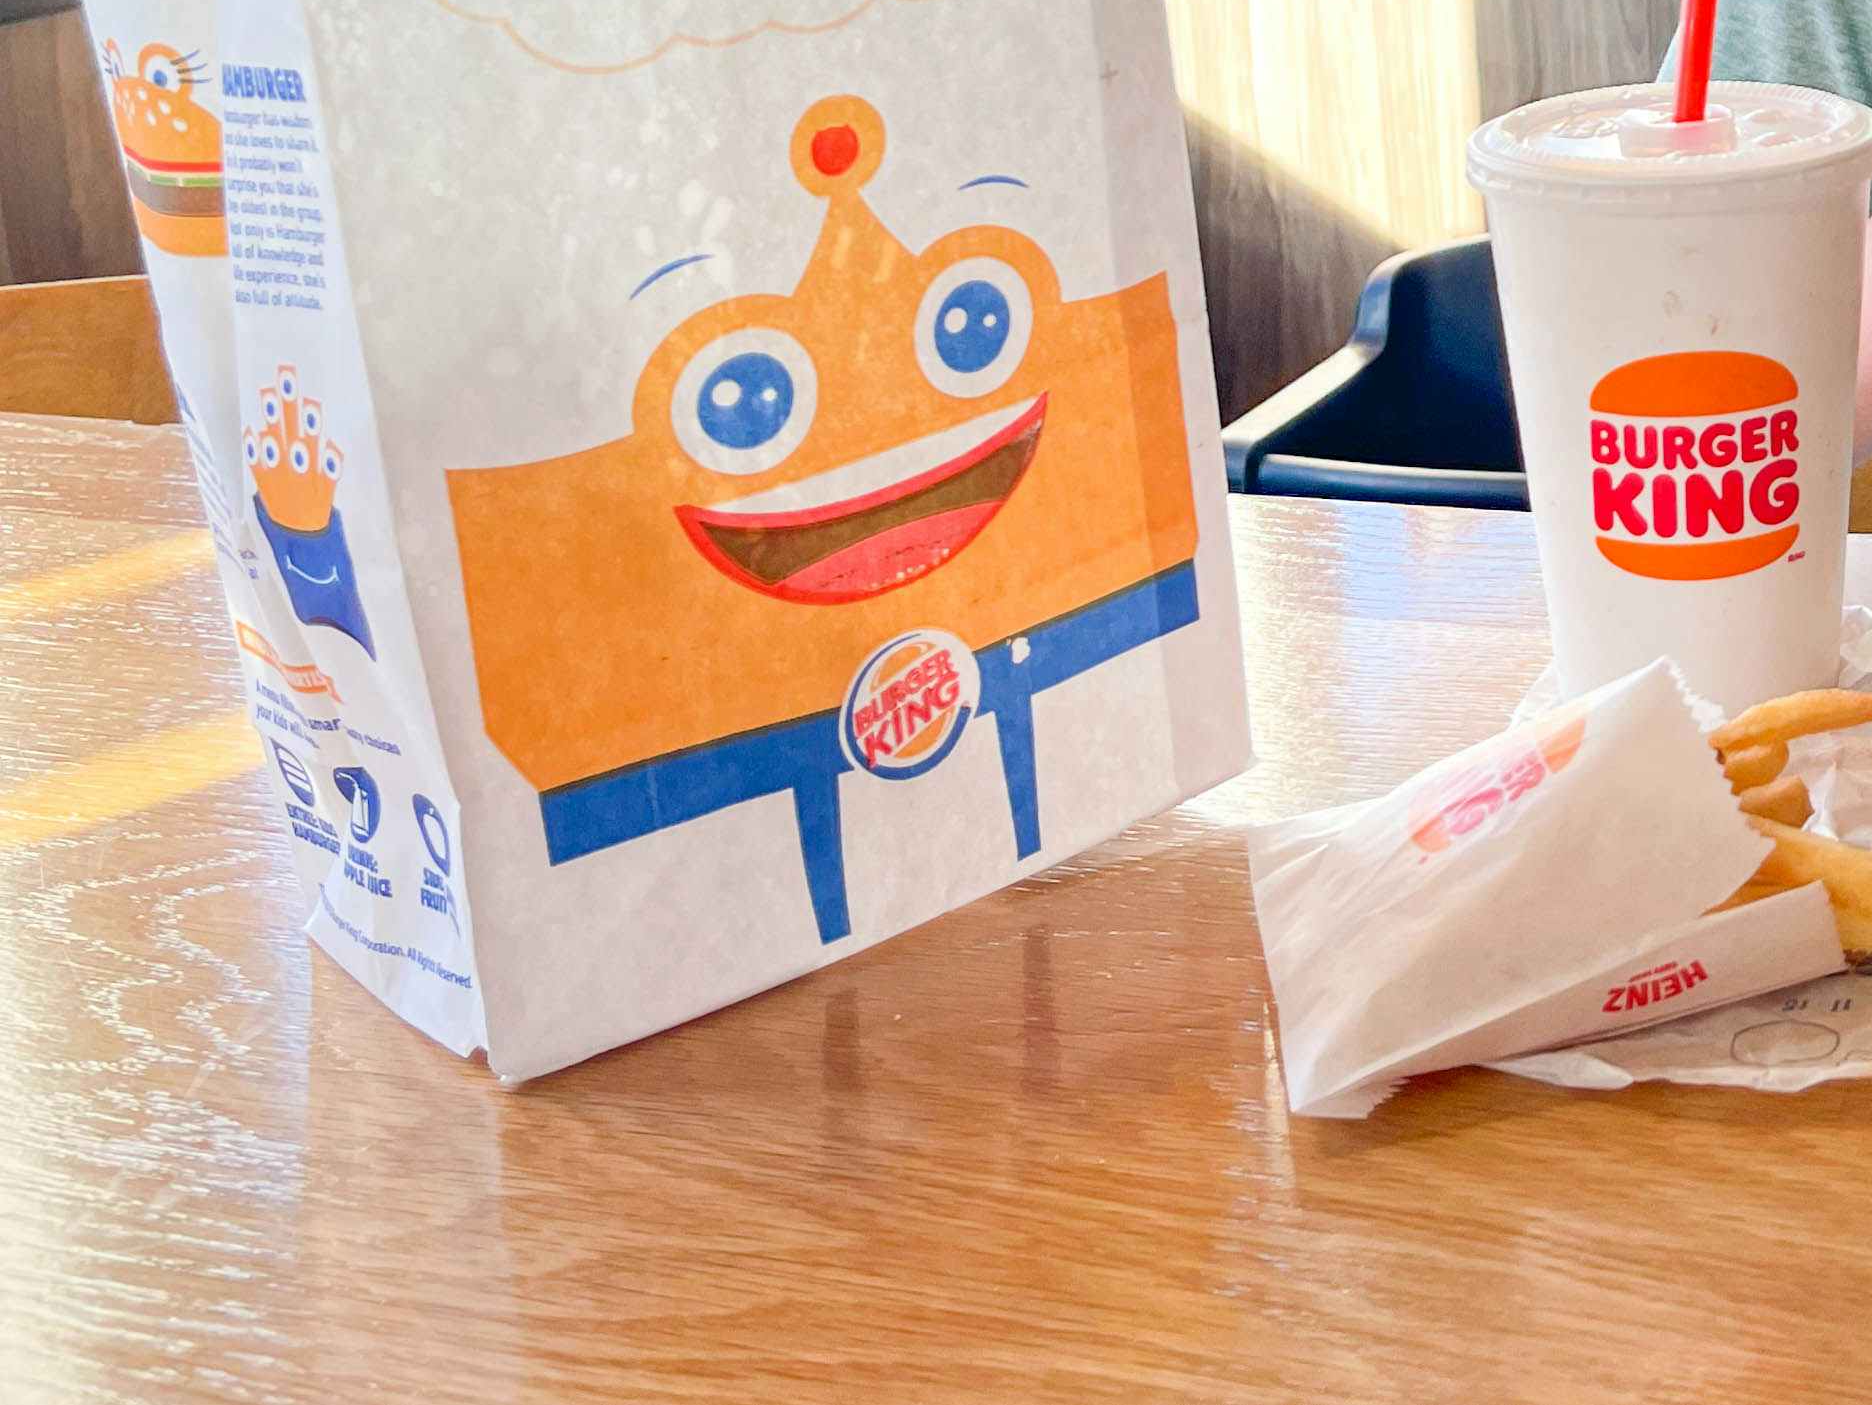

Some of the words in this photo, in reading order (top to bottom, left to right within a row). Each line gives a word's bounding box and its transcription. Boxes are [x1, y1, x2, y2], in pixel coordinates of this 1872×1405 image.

[1590, 409, 1799, 470] BURGER
[1593, 458, 1800, 538] KING
[854, 649, 960, 738] BURGER
[864, 680, 961, 769] KING
[1602, 960, 1708, 1012] HEINZ
